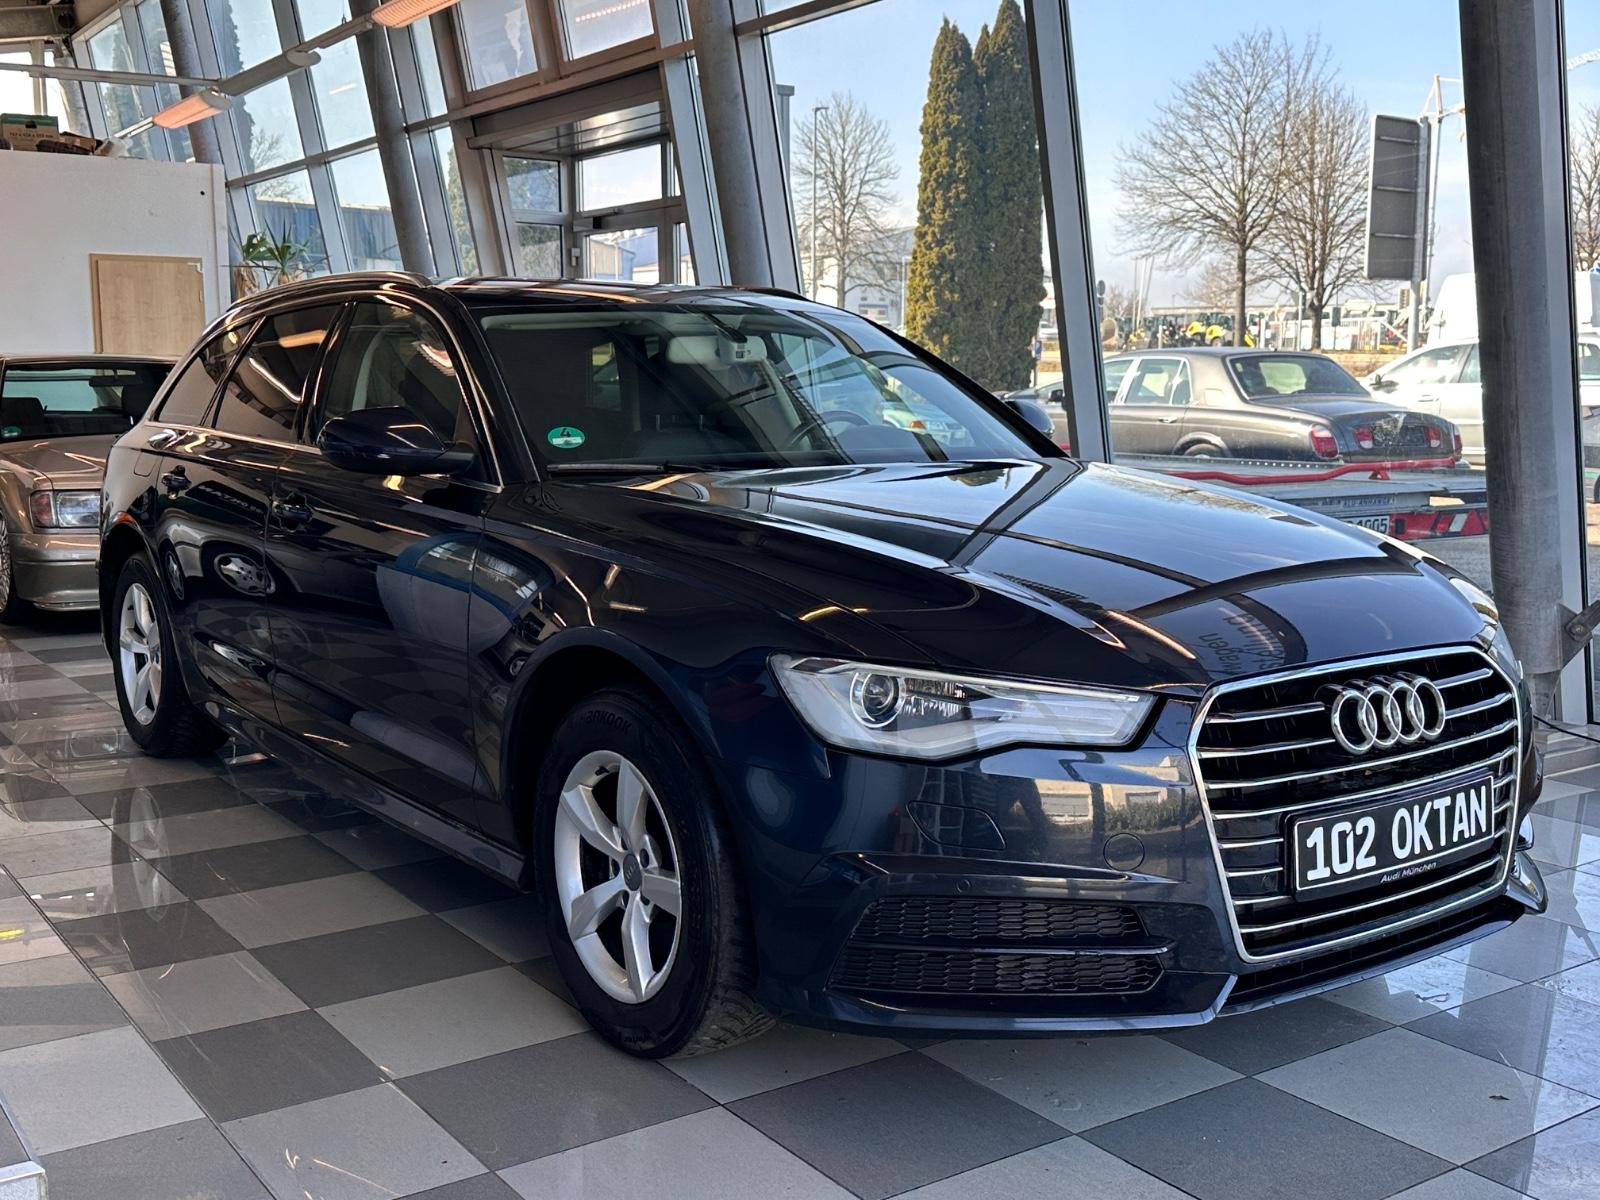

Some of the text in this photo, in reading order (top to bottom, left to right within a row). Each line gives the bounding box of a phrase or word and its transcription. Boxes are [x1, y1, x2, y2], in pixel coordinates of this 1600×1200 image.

[1306, 785, 1487, 881] 102 OKTAN
[1380, 861, 1437, 884] Audi München
